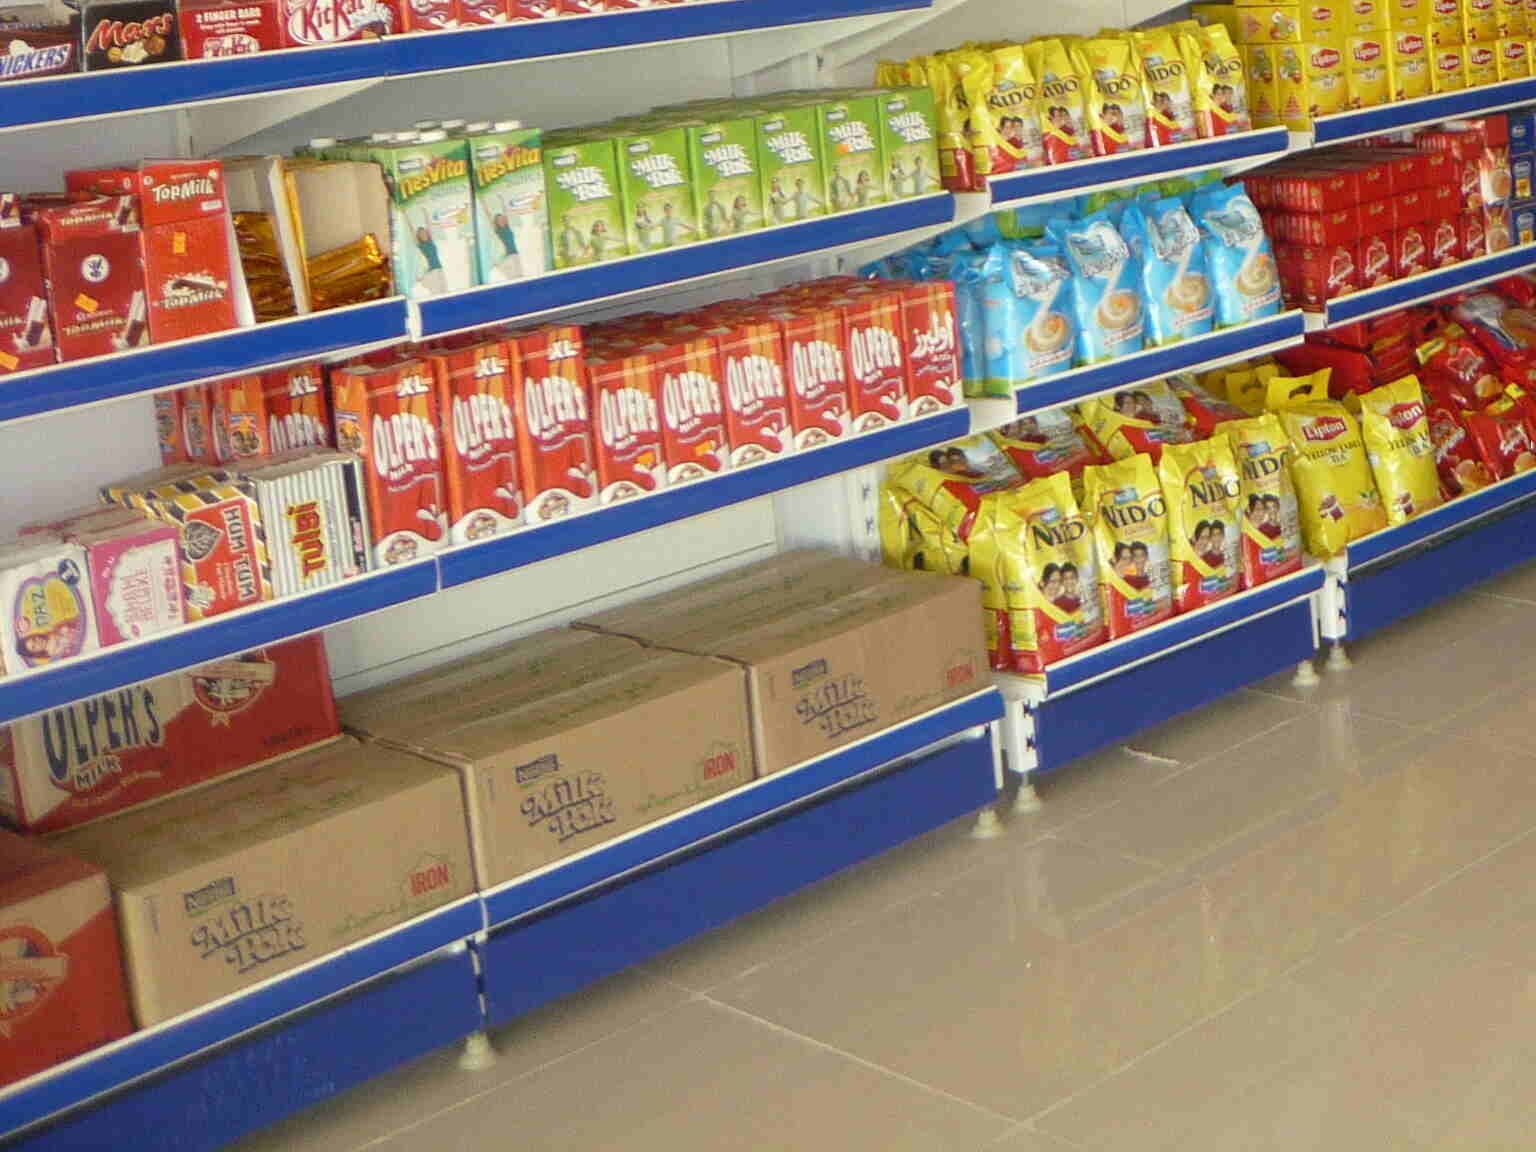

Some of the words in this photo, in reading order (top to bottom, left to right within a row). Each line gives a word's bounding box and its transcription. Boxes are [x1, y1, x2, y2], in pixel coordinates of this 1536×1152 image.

[87, 13, 174, 54] Mars
[1303, 421, 1345, 441] Lipton
[1102, 497, 1167, 529] NIDO
[703, 751, 737, 781] IRON
[408, 863, 450, 897] IRON
